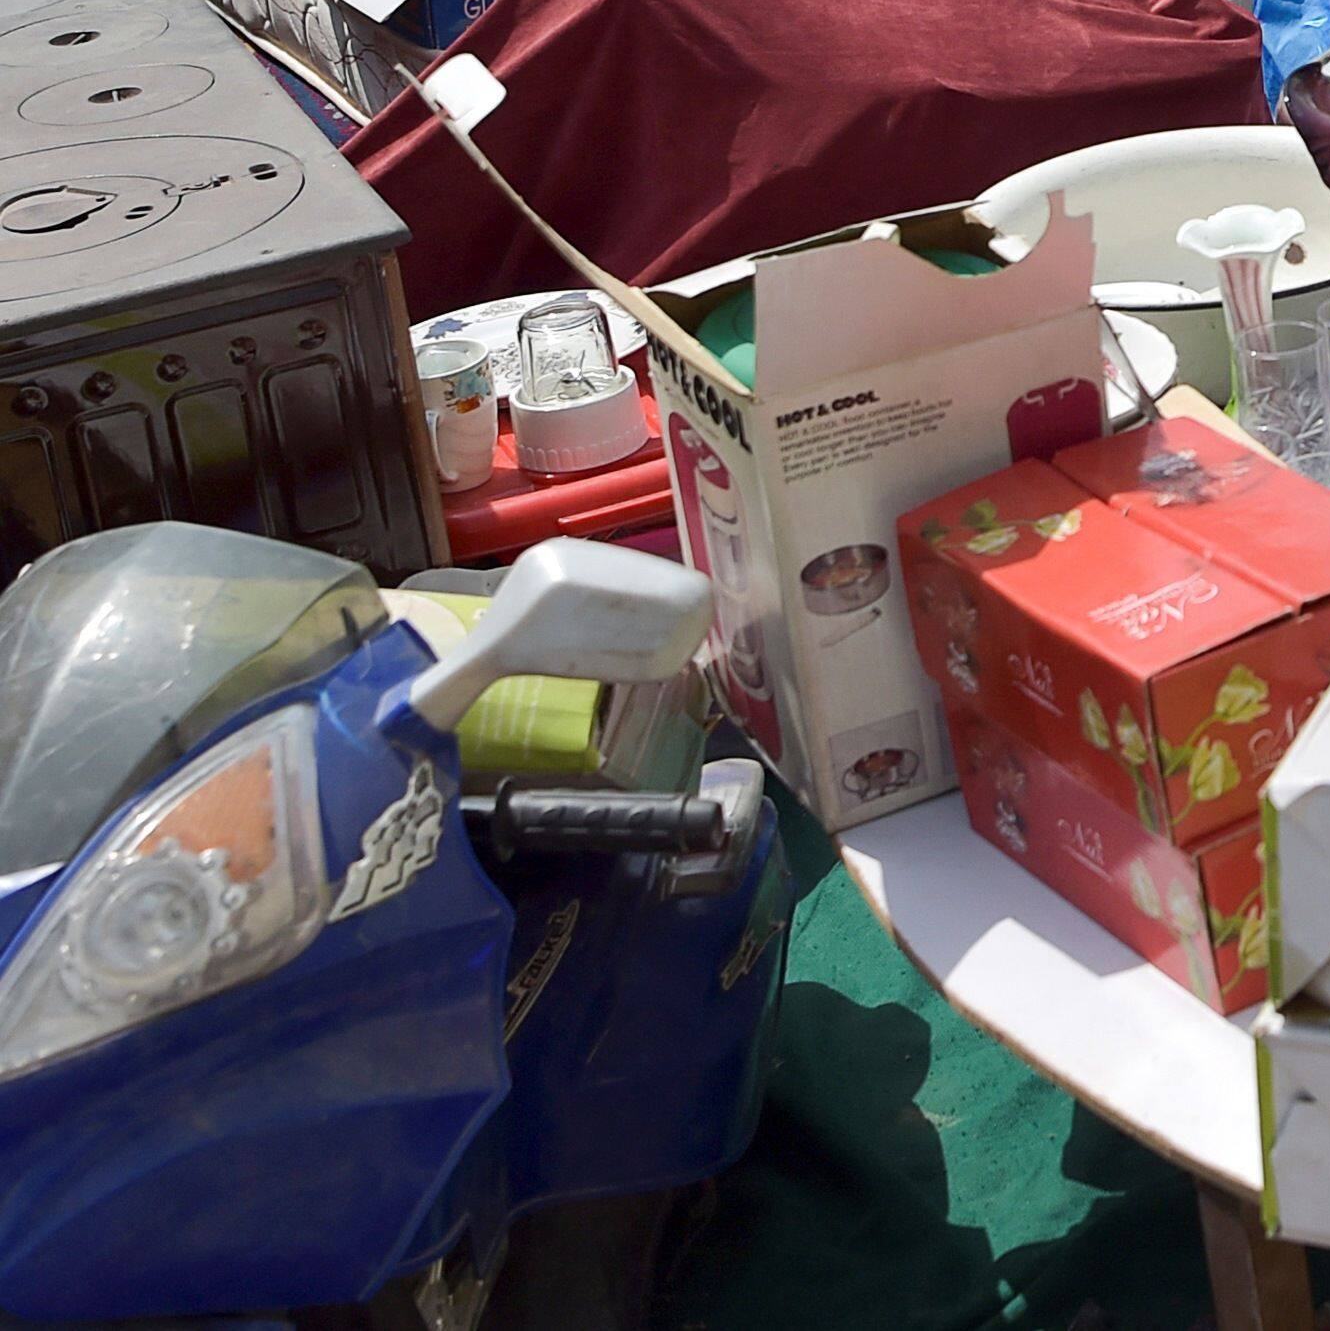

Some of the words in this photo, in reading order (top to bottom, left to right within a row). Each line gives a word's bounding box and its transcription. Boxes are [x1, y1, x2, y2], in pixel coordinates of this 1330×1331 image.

[776, 406, 815, 429] HOT
[817, 403, 830, 418] &
[831, 390, 881, 413] COOL
